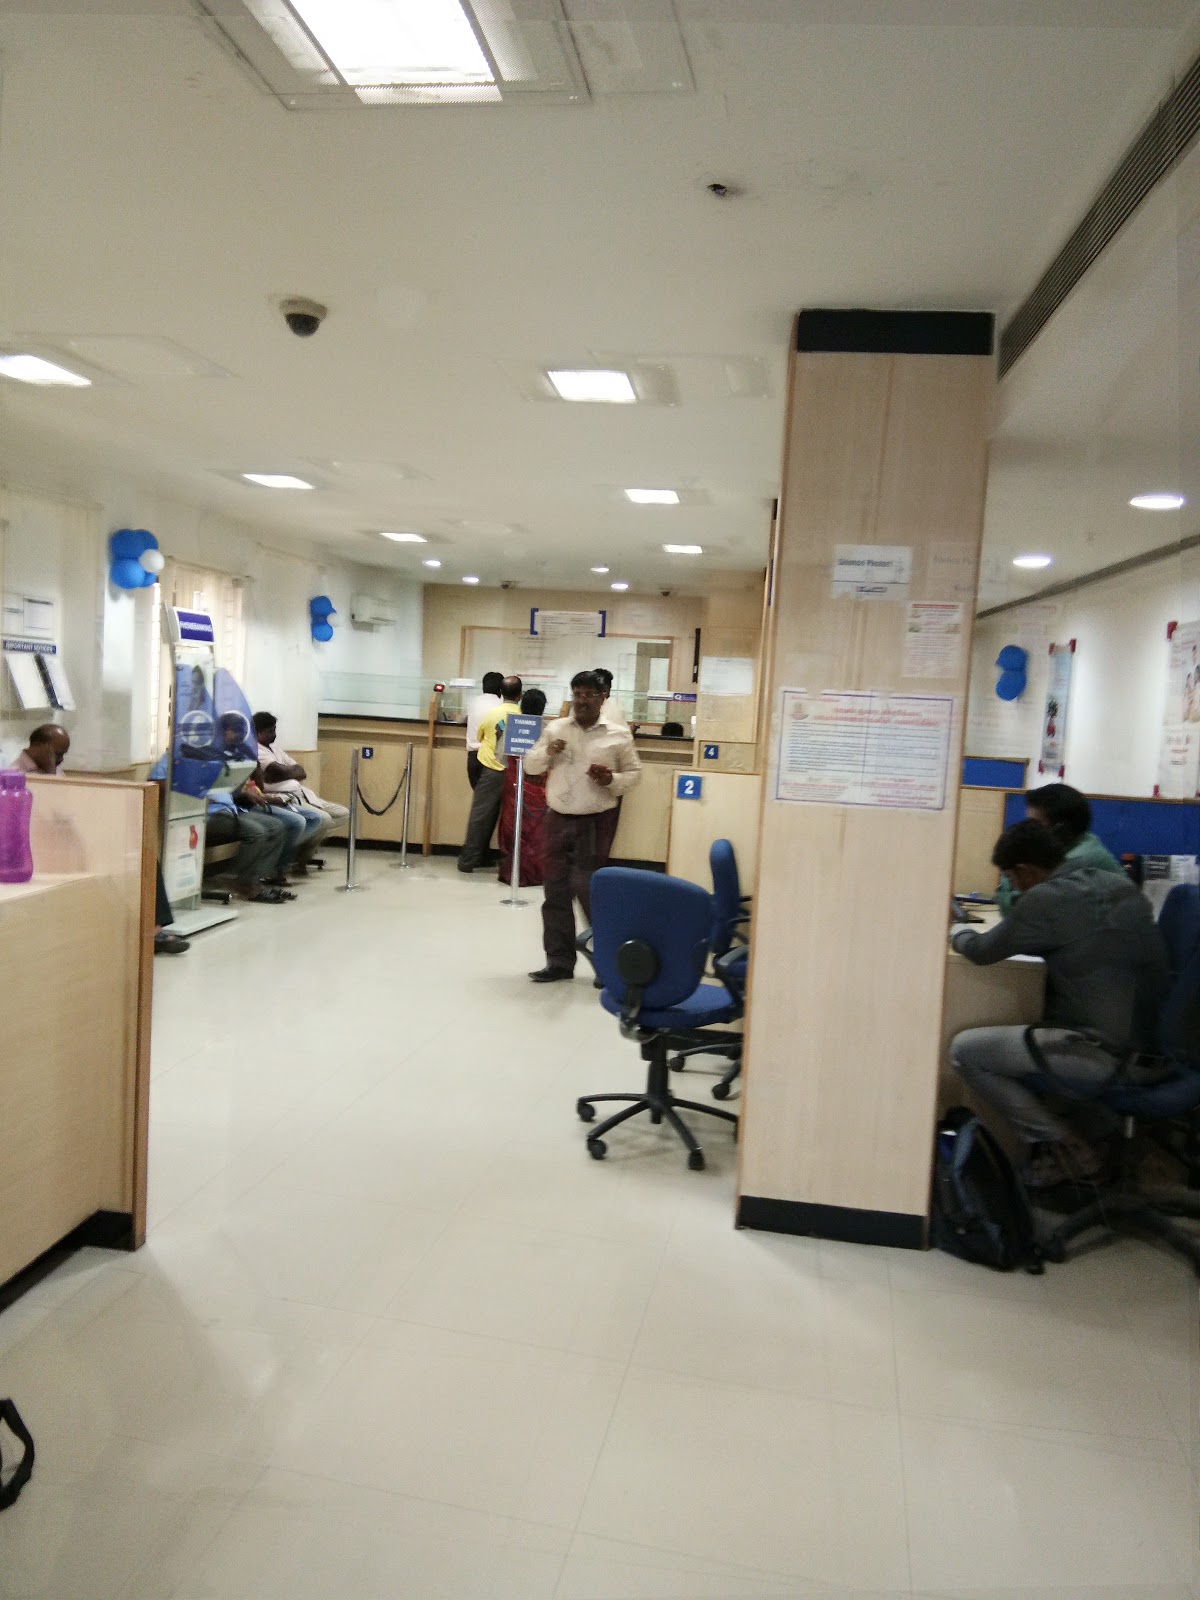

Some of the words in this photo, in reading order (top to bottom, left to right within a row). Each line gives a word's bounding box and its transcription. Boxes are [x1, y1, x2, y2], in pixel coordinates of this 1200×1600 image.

[6, 641, 33, 651] IMPORTANT
[708, 747, 715, 756] 4
[684, 780, 695, 795] 2
